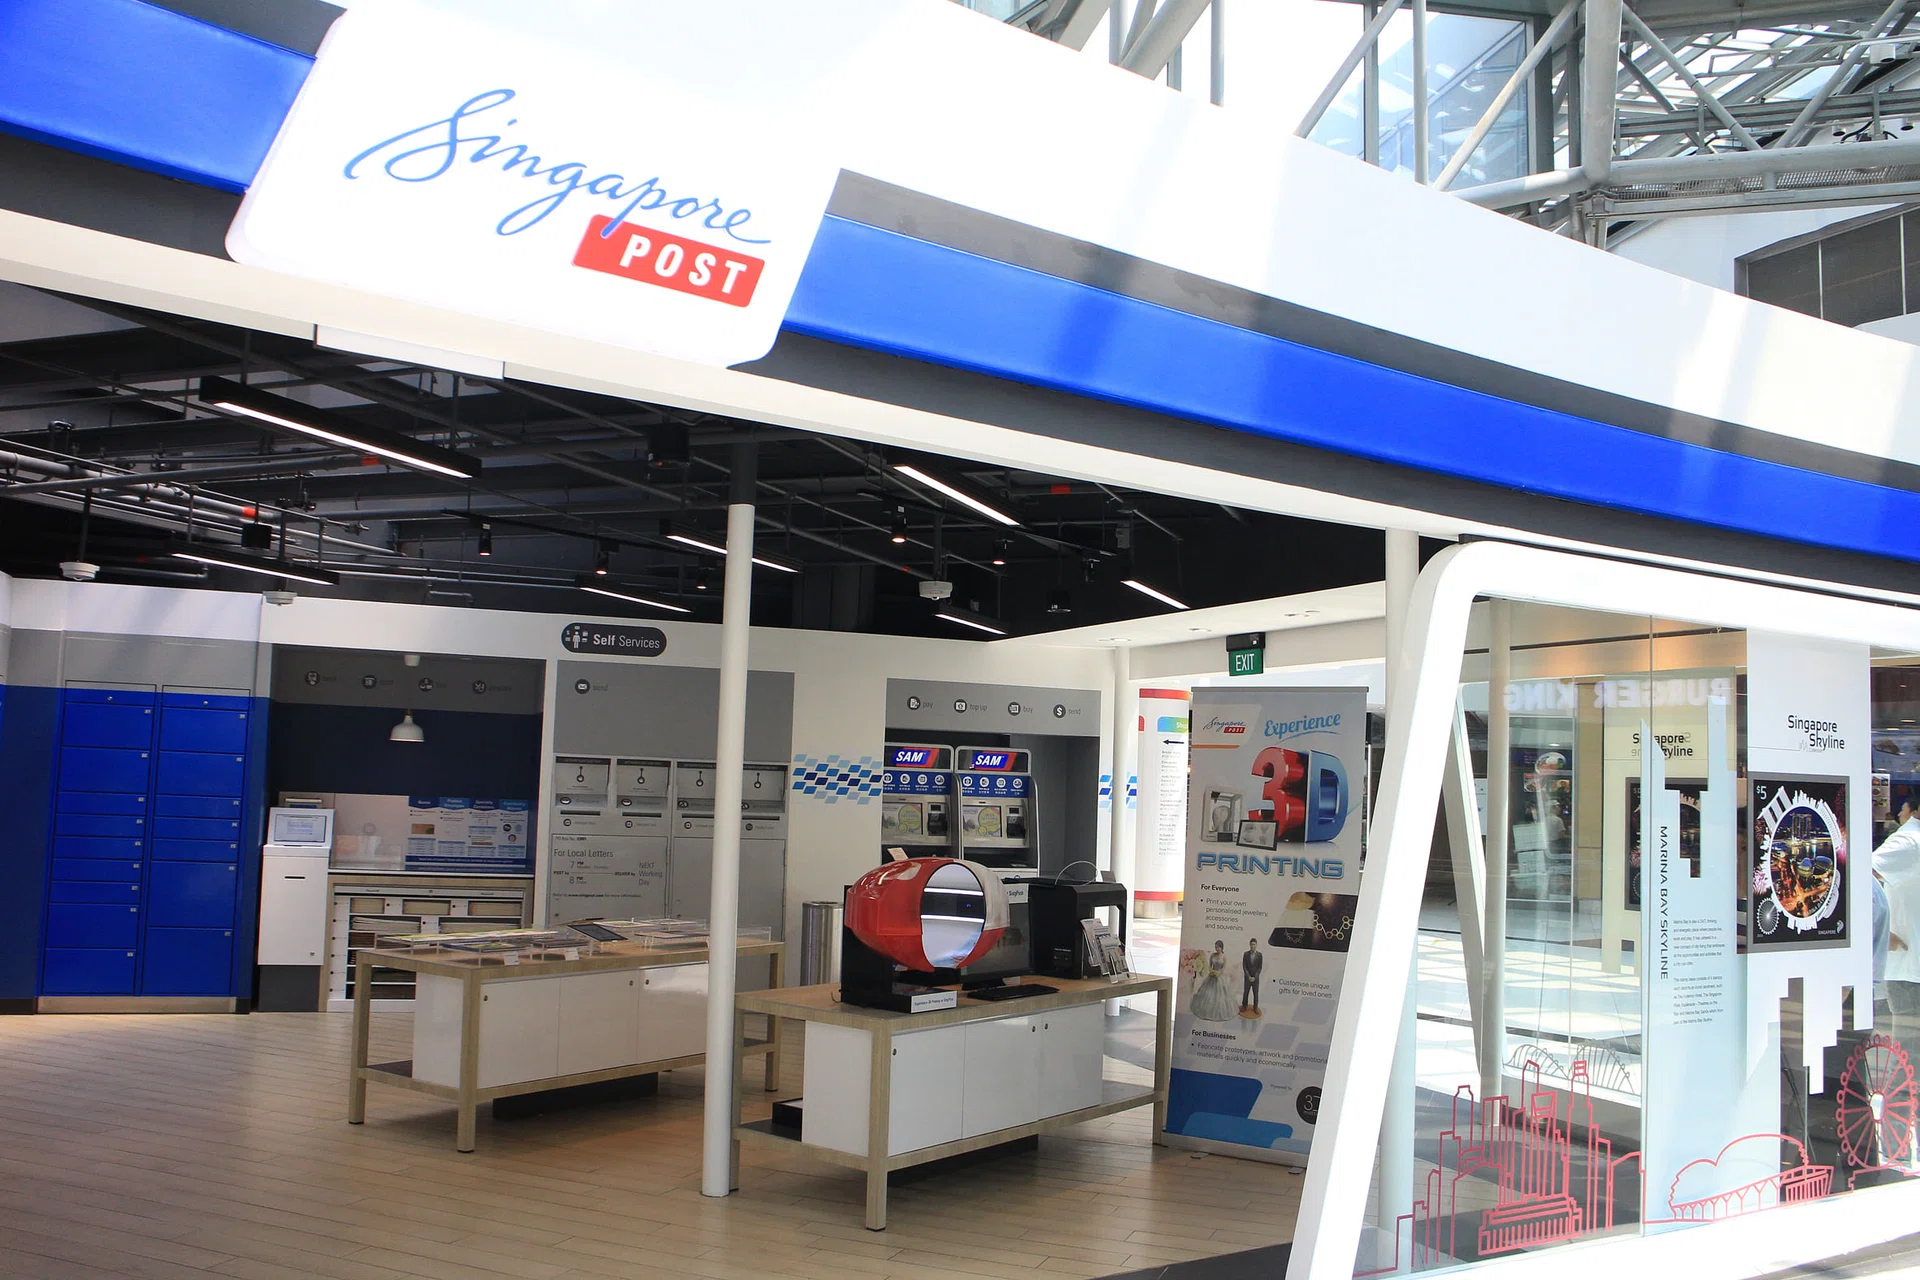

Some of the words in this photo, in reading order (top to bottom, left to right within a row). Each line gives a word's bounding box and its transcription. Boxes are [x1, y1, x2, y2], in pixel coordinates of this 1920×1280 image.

[343, 89, 771, 243] Singapore
[619, 233, 747, 295] POST
[593, 633, 616, 646] Self
[619, 635, 660, 649] Services
[1235, 653, 1255, 672] EXIT
[922, 701, 934, 709] pay
[1068, 707, 1082, 715] send
[1264, 713, 1341, 739] Experience
[1787, 715, 1838, 735] Singapore
[1809, 733, 1845, 751] Skyline
[895, 751, 924, 762] SAM
[975, 755, 1002, 766] SAM
[1248, 746, 1348, 844] 3D
[1756, 785, 1767, 800] $5
[554, 848, 565, 857] For
[567, 849, 586, 857] Local
[588, 849, 614, 858] Letters
[1660, 826, 1668, 885] MARINA
[570, 861, 575, 869] 7
[1196, 851, 1344, 879] PRINTING
[639, 870, 663, 878] Working
[638, 878, 650, 886] Day
[1201, 883, 1211, 891] For
[1211, 884, 1240, 893] Everyone
[1219, 899, 1232, 907] your
[1660, 888, 1668, 916] BAY
[1205, 907, 1241, 915] personalised
[1205, 915, 1239, 923] accessories
[1660, 919, 1668, 980] SKYLINE
[1278, 979, 1309, 988] Customise
[1202, 1030, 1236, 1040] Businesses
[1196, 1051, 1223, 1059] materials
[1197, 1042, 1224, 1052] Fabricate
[1259, 1050, 1281, 1058] artwork
